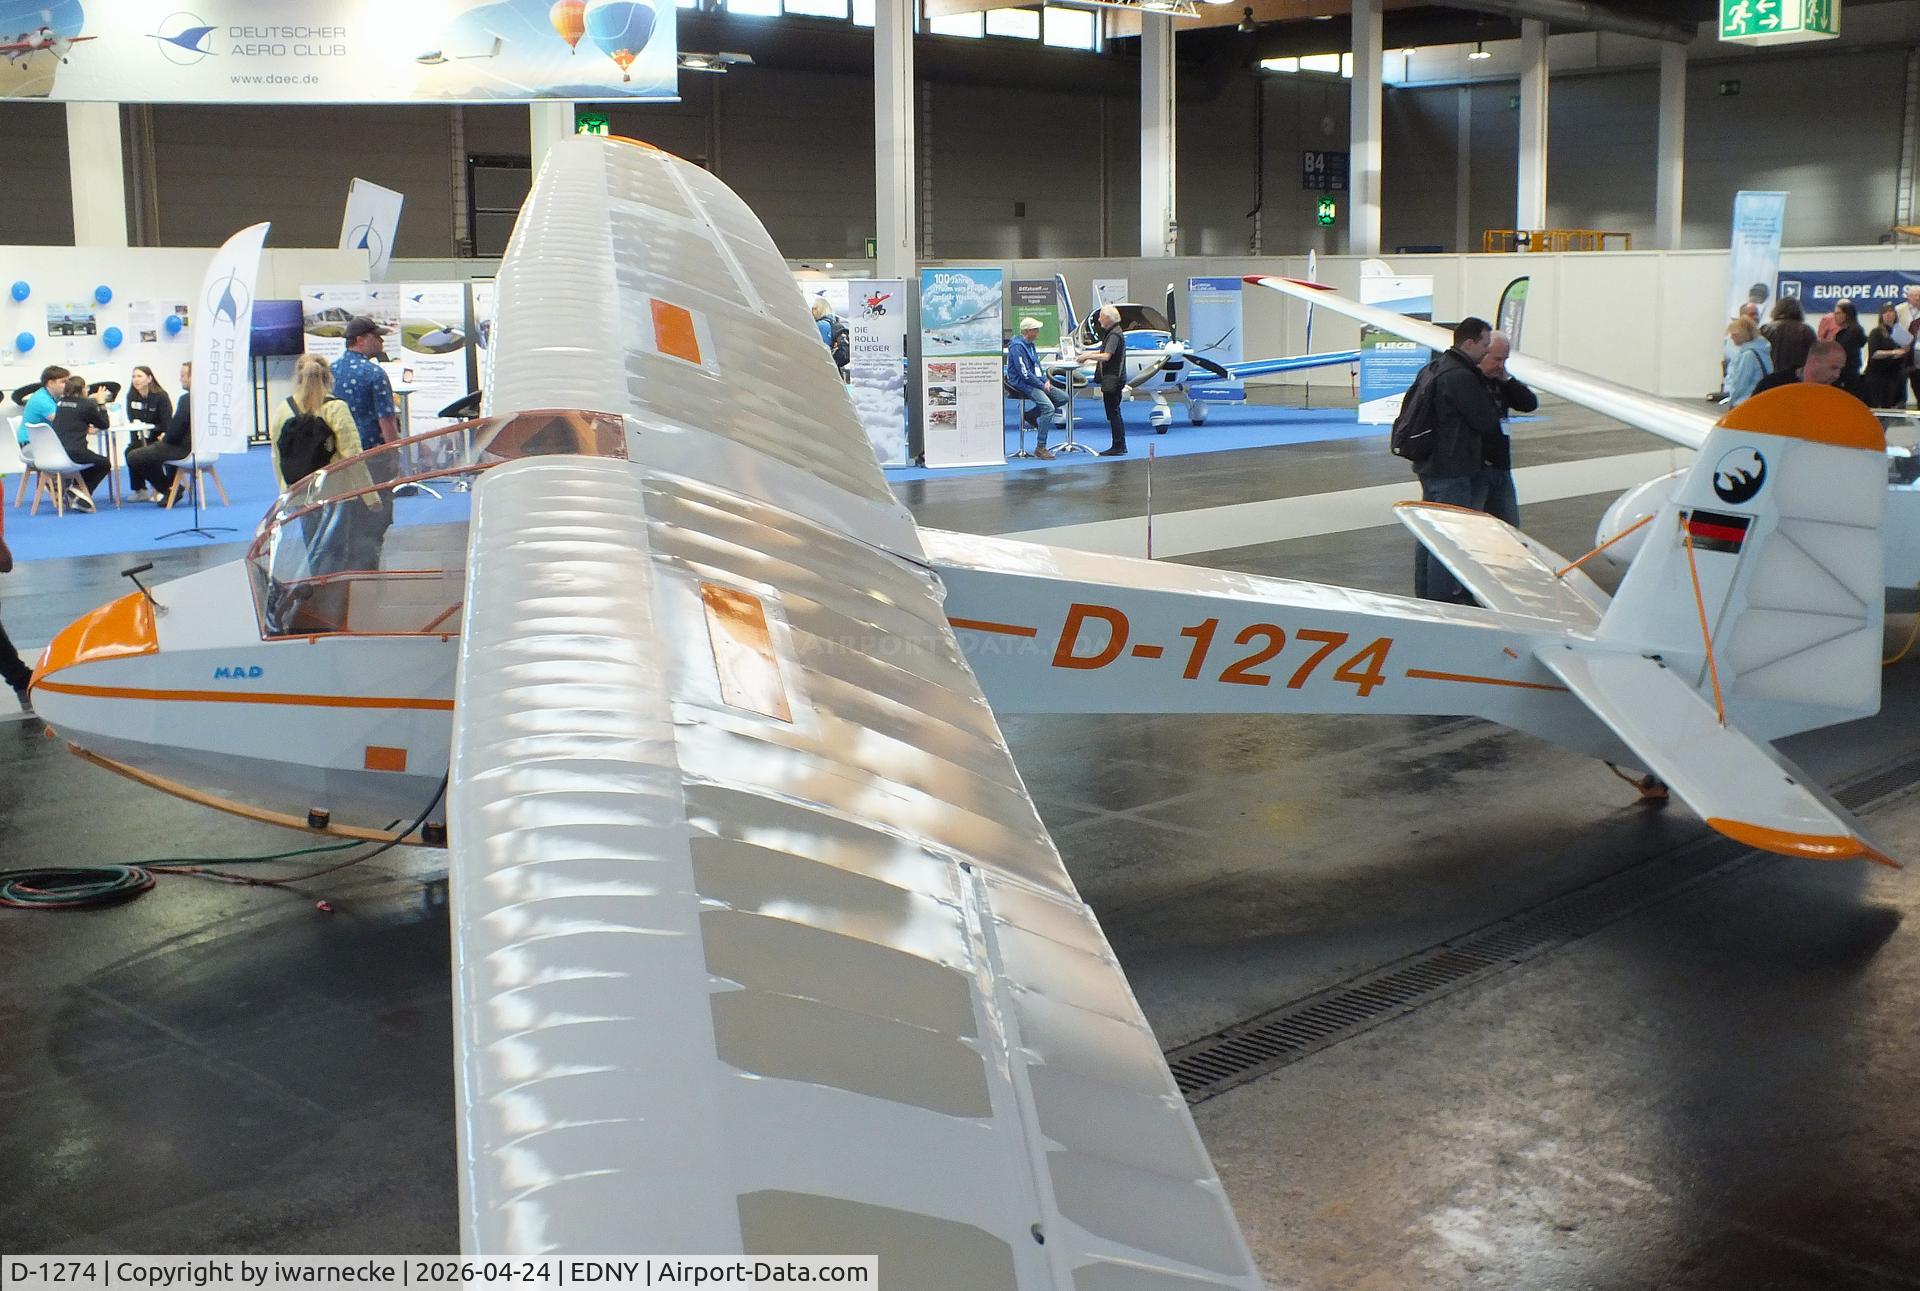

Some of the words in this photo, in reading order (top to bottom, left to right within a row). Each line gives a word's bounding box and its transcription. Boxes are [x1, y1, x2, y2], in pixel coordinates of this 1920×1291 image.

[229, 26, 346, 38] DEUTSCHER
[231, 44, 286, 56] AERO
[293, 44, 346, 56] CLUB
[230, 74, 319, 84] www.daec.de
[934, 273, 950, 284] 100
[1812, 285, 1872, 299] EUROPE
[1873, 284, 1899, 299] AIR
[208, 338, 221, 385] AERO
[222, 338, 234, 438] DEUTSCHER
[207, 391, 219, 437] CLUB
[1051, 603, 1394, 697] D-1274
